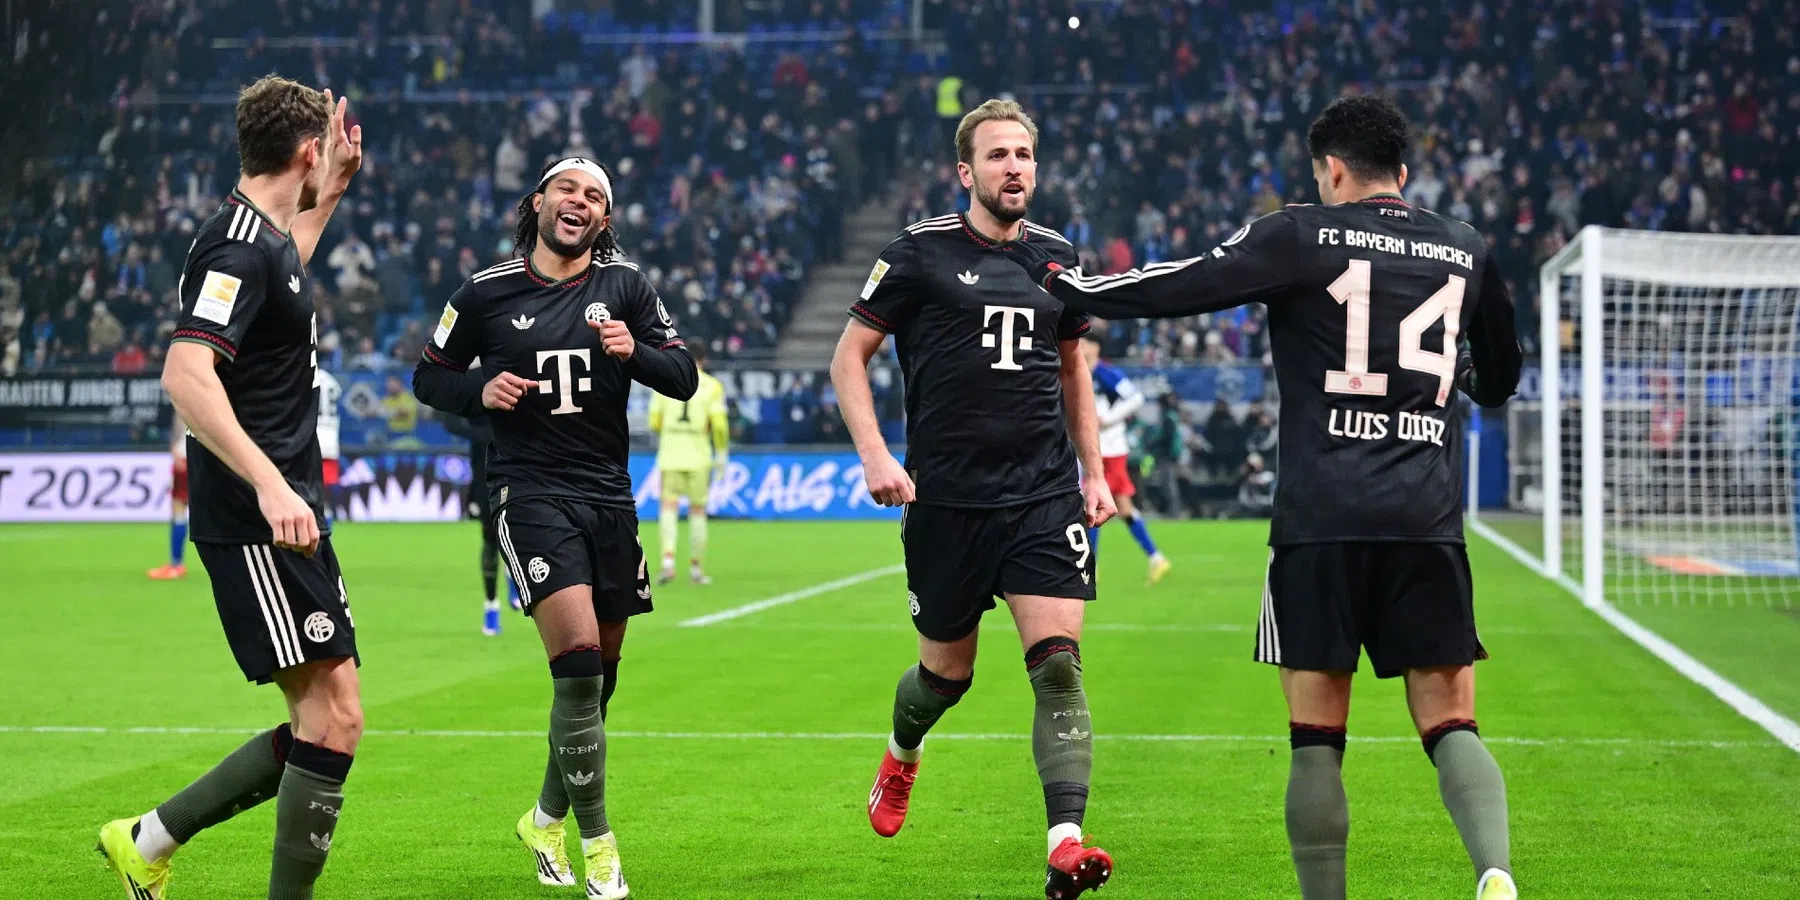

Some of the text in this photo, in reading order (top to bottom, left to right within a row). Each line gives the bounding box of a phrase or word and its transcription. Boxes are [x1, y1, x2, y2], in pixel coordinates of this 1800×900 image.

[1379, 208, 1408, 218] FCBM
[1318, 228, 1339, 245] FC
[1345, 229, 1405, 255] BAYERN
[982, 304, 1035, 371] T
[1324, 258, 1466, 408] 14
[536, 348, 592, 415] T
[1328, 408, 1446, 447] LUIS DÍAZ
[1065, 522, 1090, 569] 9
[559, 742, 598, 755] FCBM
